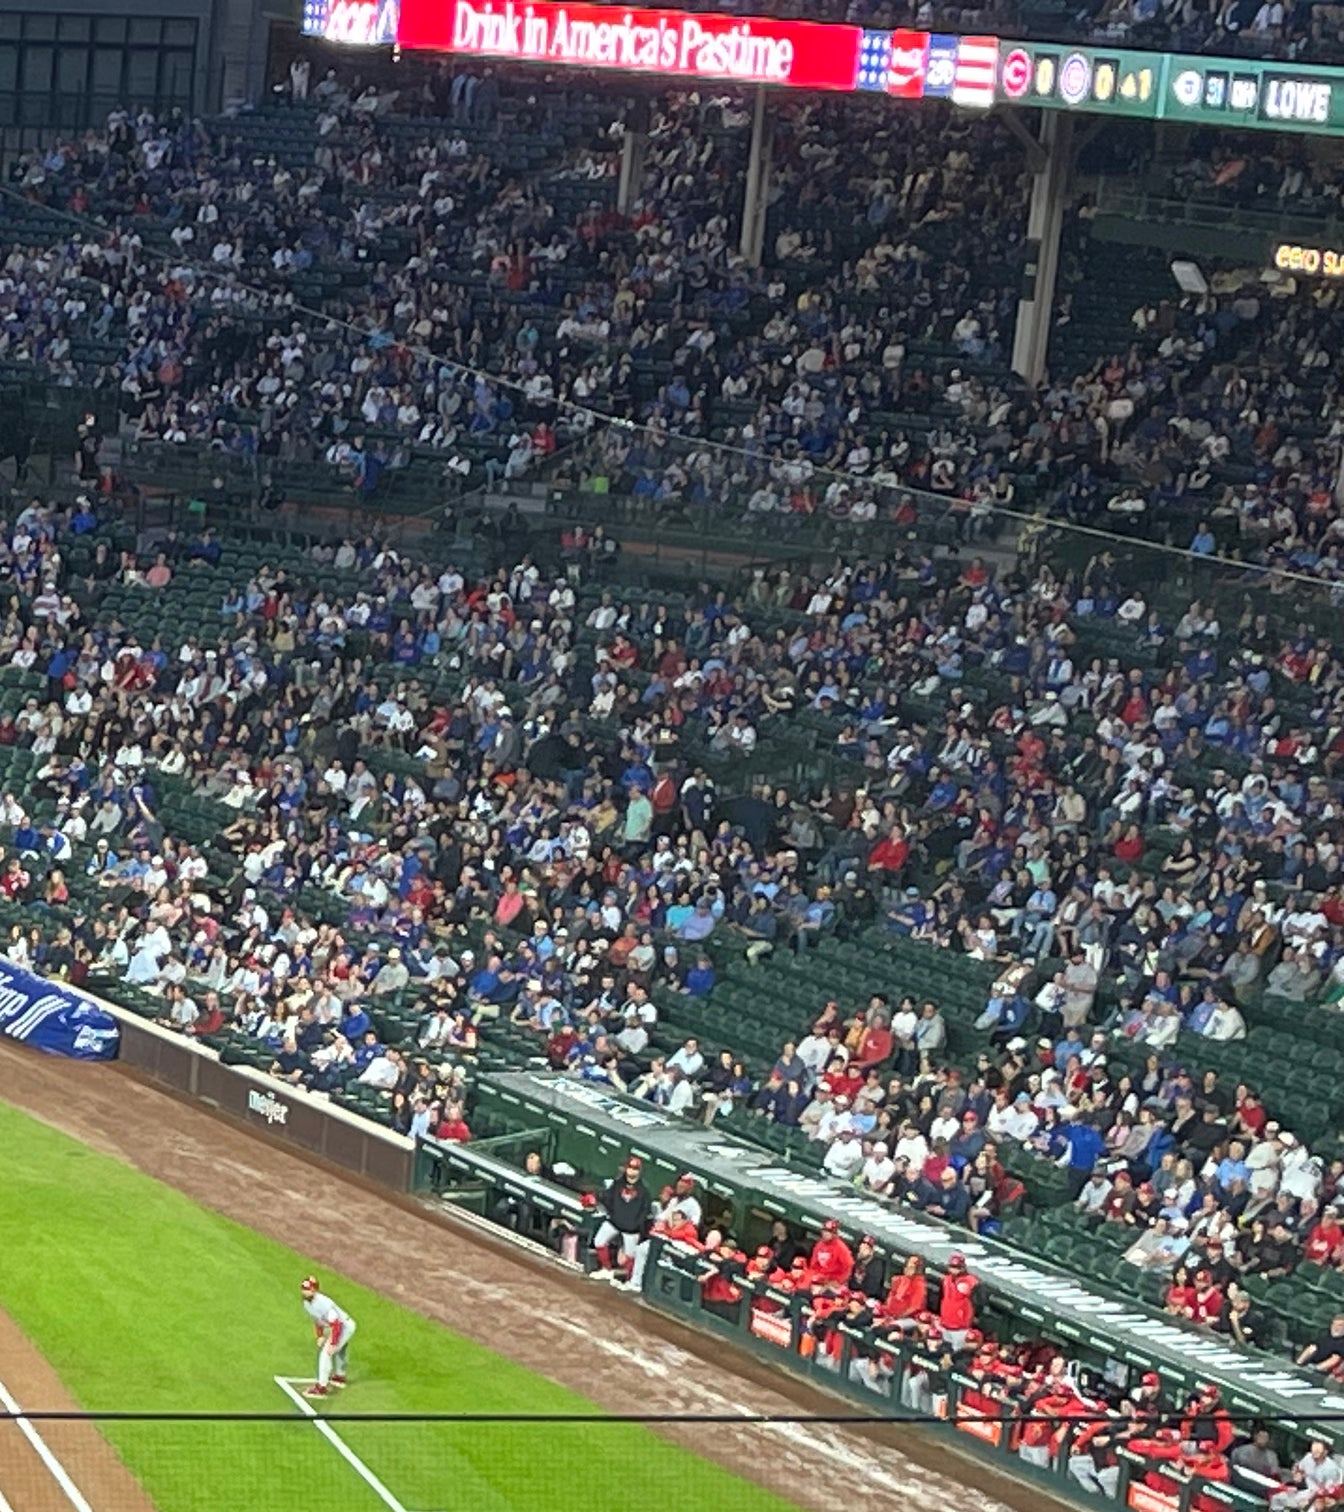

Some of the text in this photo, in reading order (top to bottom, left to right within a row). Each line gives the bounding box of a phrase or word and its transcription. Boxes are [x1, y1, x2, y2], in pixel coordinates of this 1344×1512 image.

[455, 0, 794, 78] Drink in America's Pastime
[1264, 79, 1333, 123] LOWE
